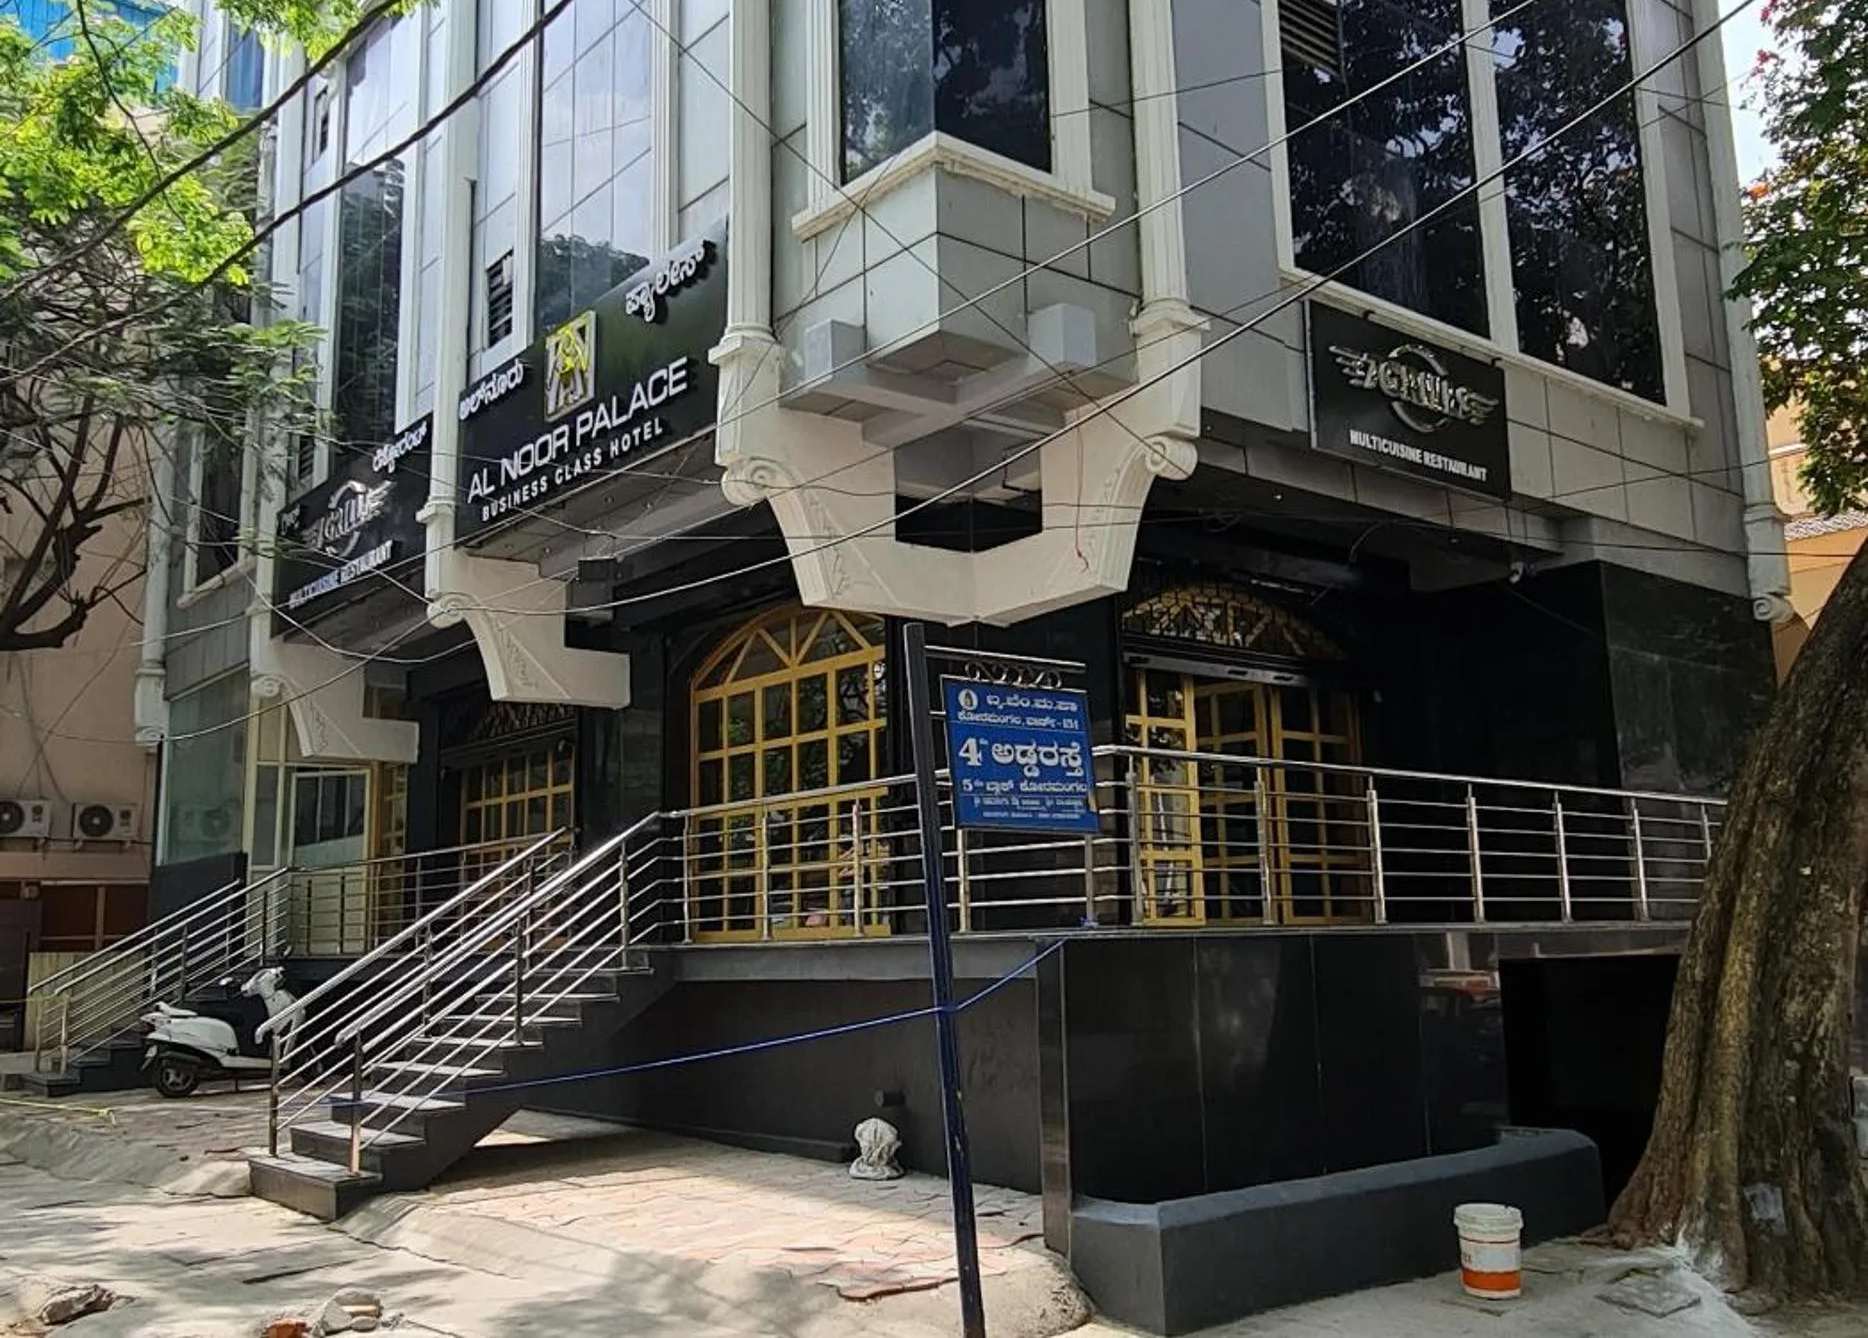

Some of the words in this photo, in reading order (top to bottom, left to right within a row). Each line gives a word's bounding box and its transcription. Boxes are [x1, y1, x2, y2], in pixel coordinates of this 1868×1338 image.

[467, 469, 495, 504] AL
[500, 425, 569, 481] NOOR
[575, 356, 688, 446] PALACE
[1349, 429, 1423, 464] MULTICUISINE
[1423, 450, 1488, 482] RESTAURANT
[482, 479, 548, 522] BUSINESS
[555, 447, 603, 484] CLASS
[610, 417, 663, 459] HOTEL
[342, 540, 393, 584] RESTAURANT
[991, 739, 1084, 778] ಅಡ್ಡರಸ್ತೆ
